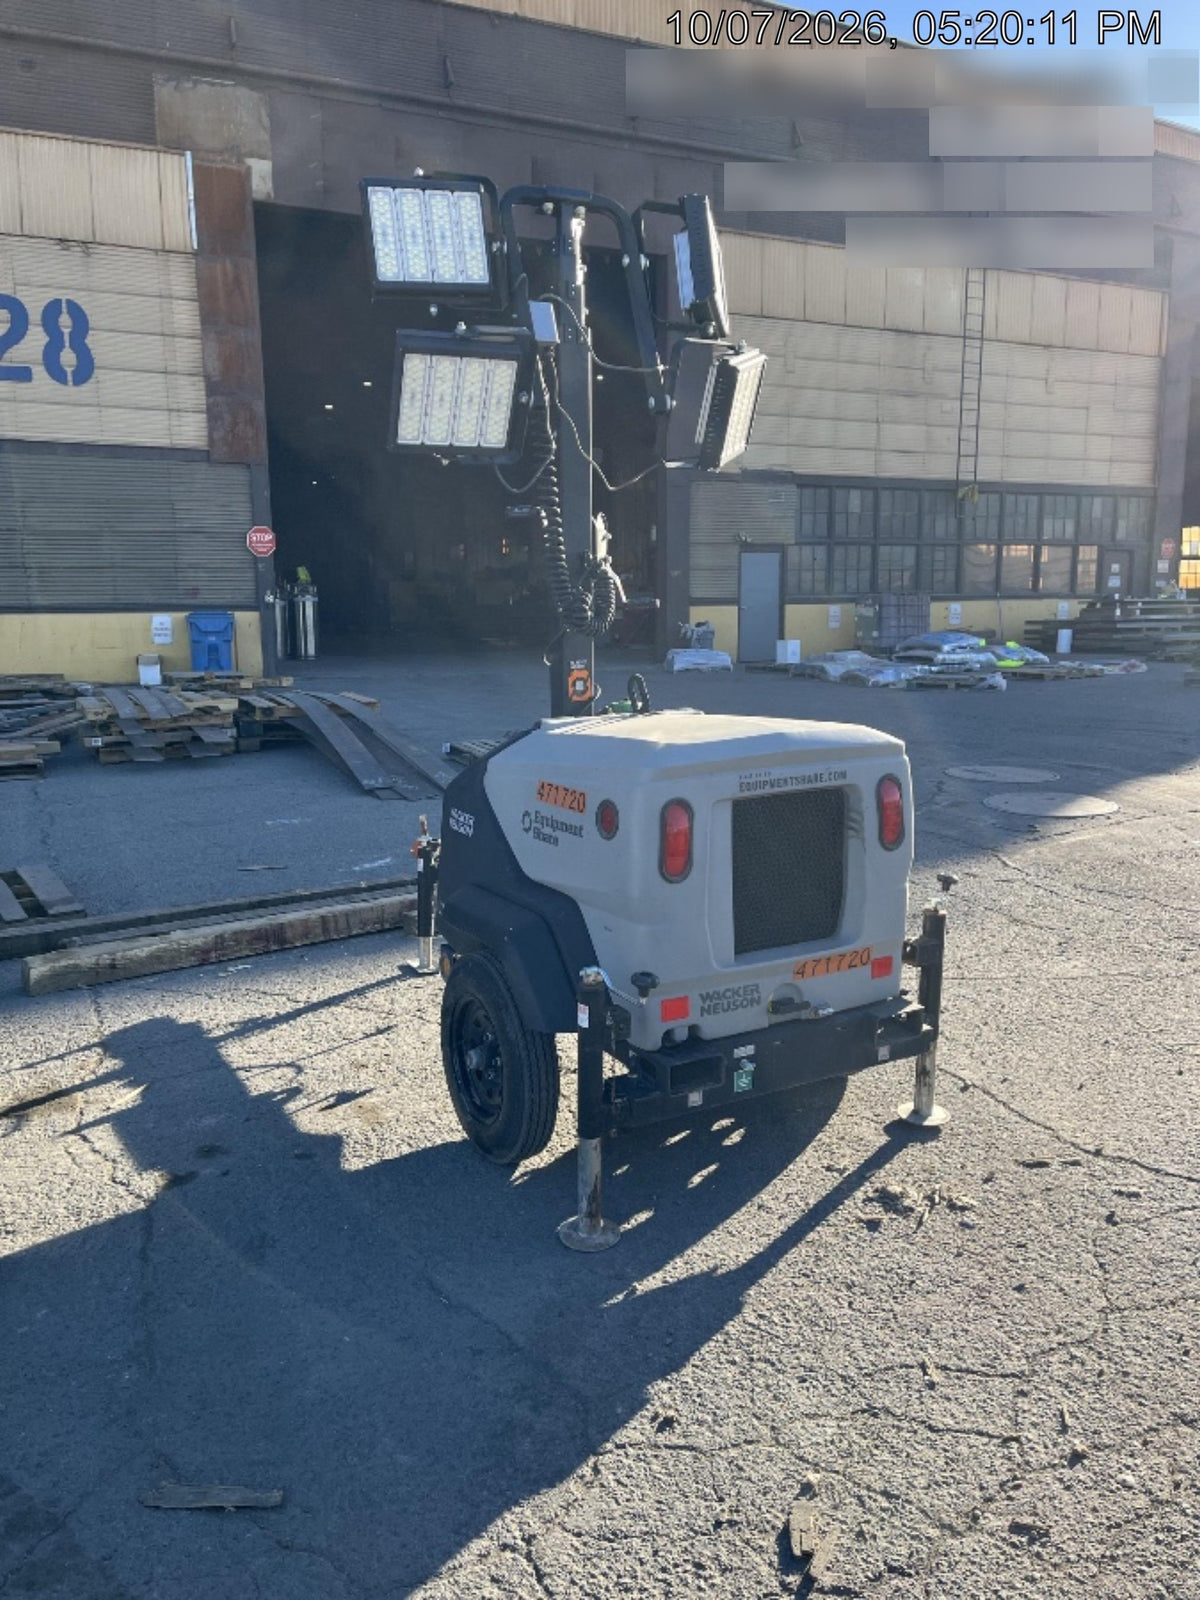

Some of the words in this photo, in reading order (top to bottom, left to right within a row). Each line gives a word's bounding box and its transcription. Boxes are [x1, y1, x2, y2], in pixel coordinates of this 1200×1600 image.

[0, 293, 95, 387] 28
[249, 532, 273, 542] STOP
[738, 769, 848, 793] EQUIPMENTSHARE.COM
[537, 782, 587, 814] 471720
[533, 810, 585, 839] Equipment
[793, 947, 872, 980] 471720
[698, 982, 761, 1004] WACKER
[699, 995, 762, 1018] NEUSON
